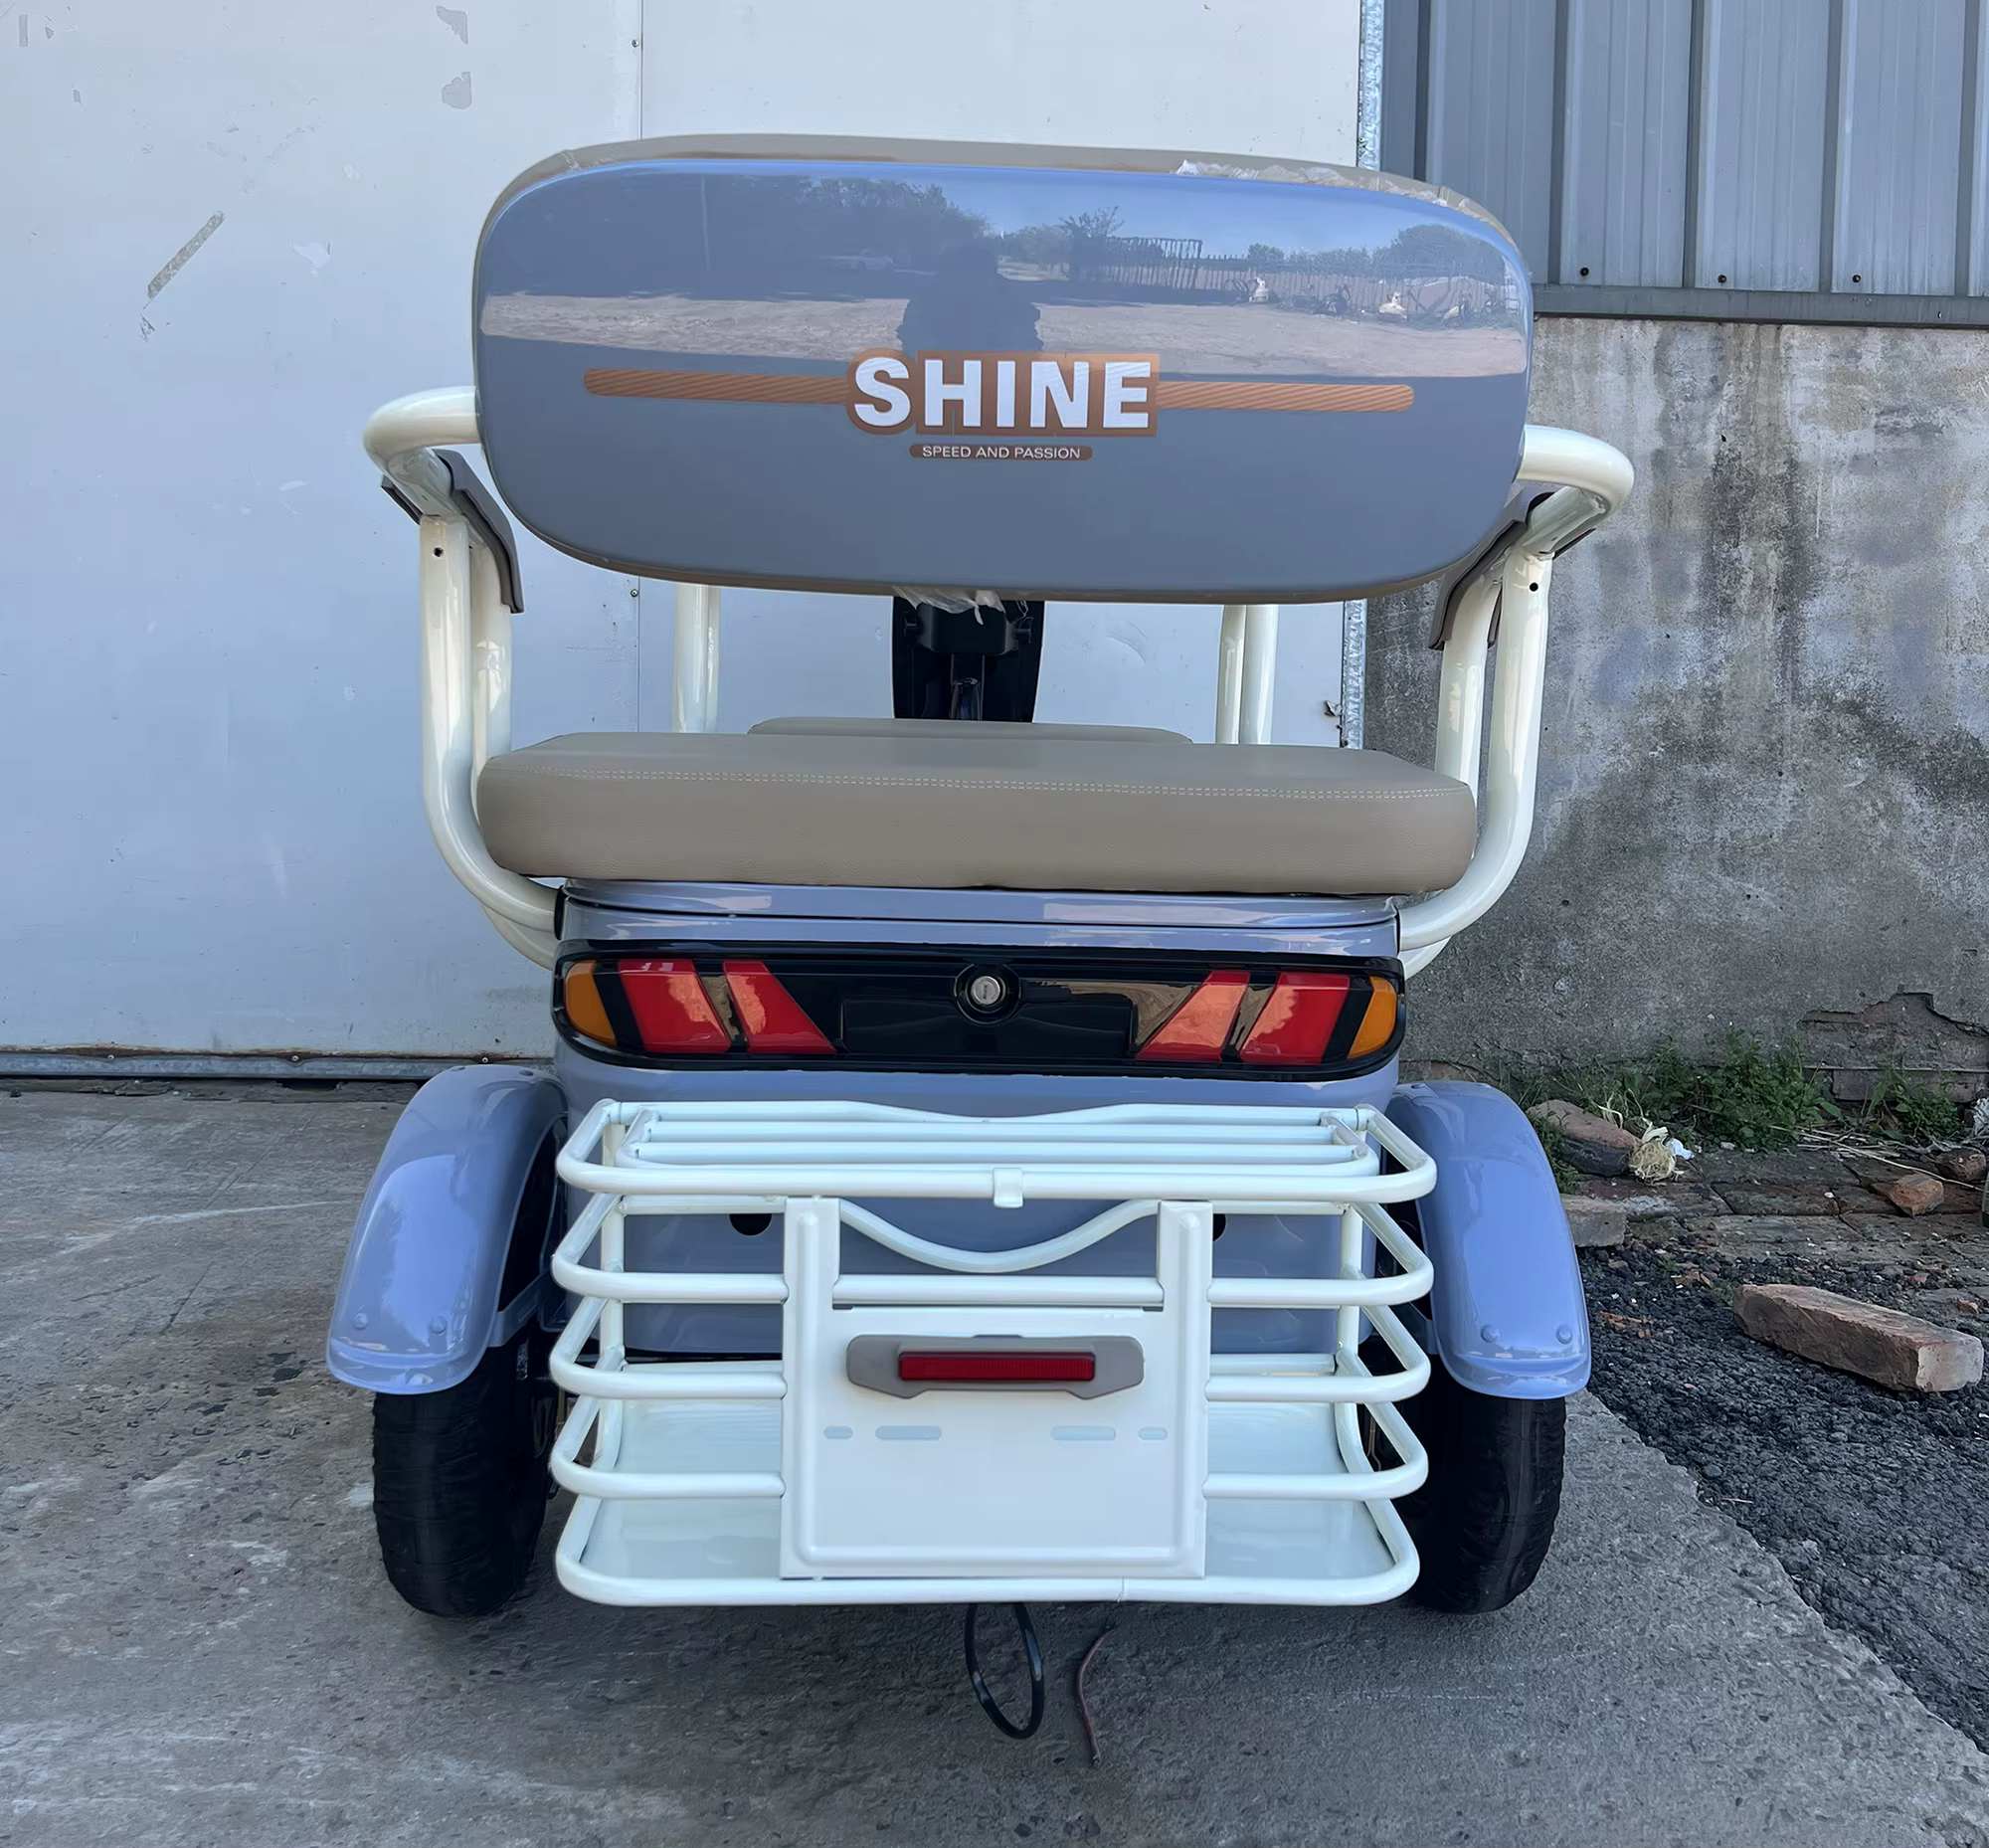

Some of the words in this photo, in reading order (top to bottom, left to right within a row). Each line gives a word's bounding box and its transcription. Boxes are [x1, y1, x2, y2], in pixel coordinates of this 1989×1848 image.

[854, 357, 1151, 429] SHINE
[922, 446, 972, 459] SPEED
[975, 447, 1010, 459] AND
[1013, 447, 1082, 460] PASSION
